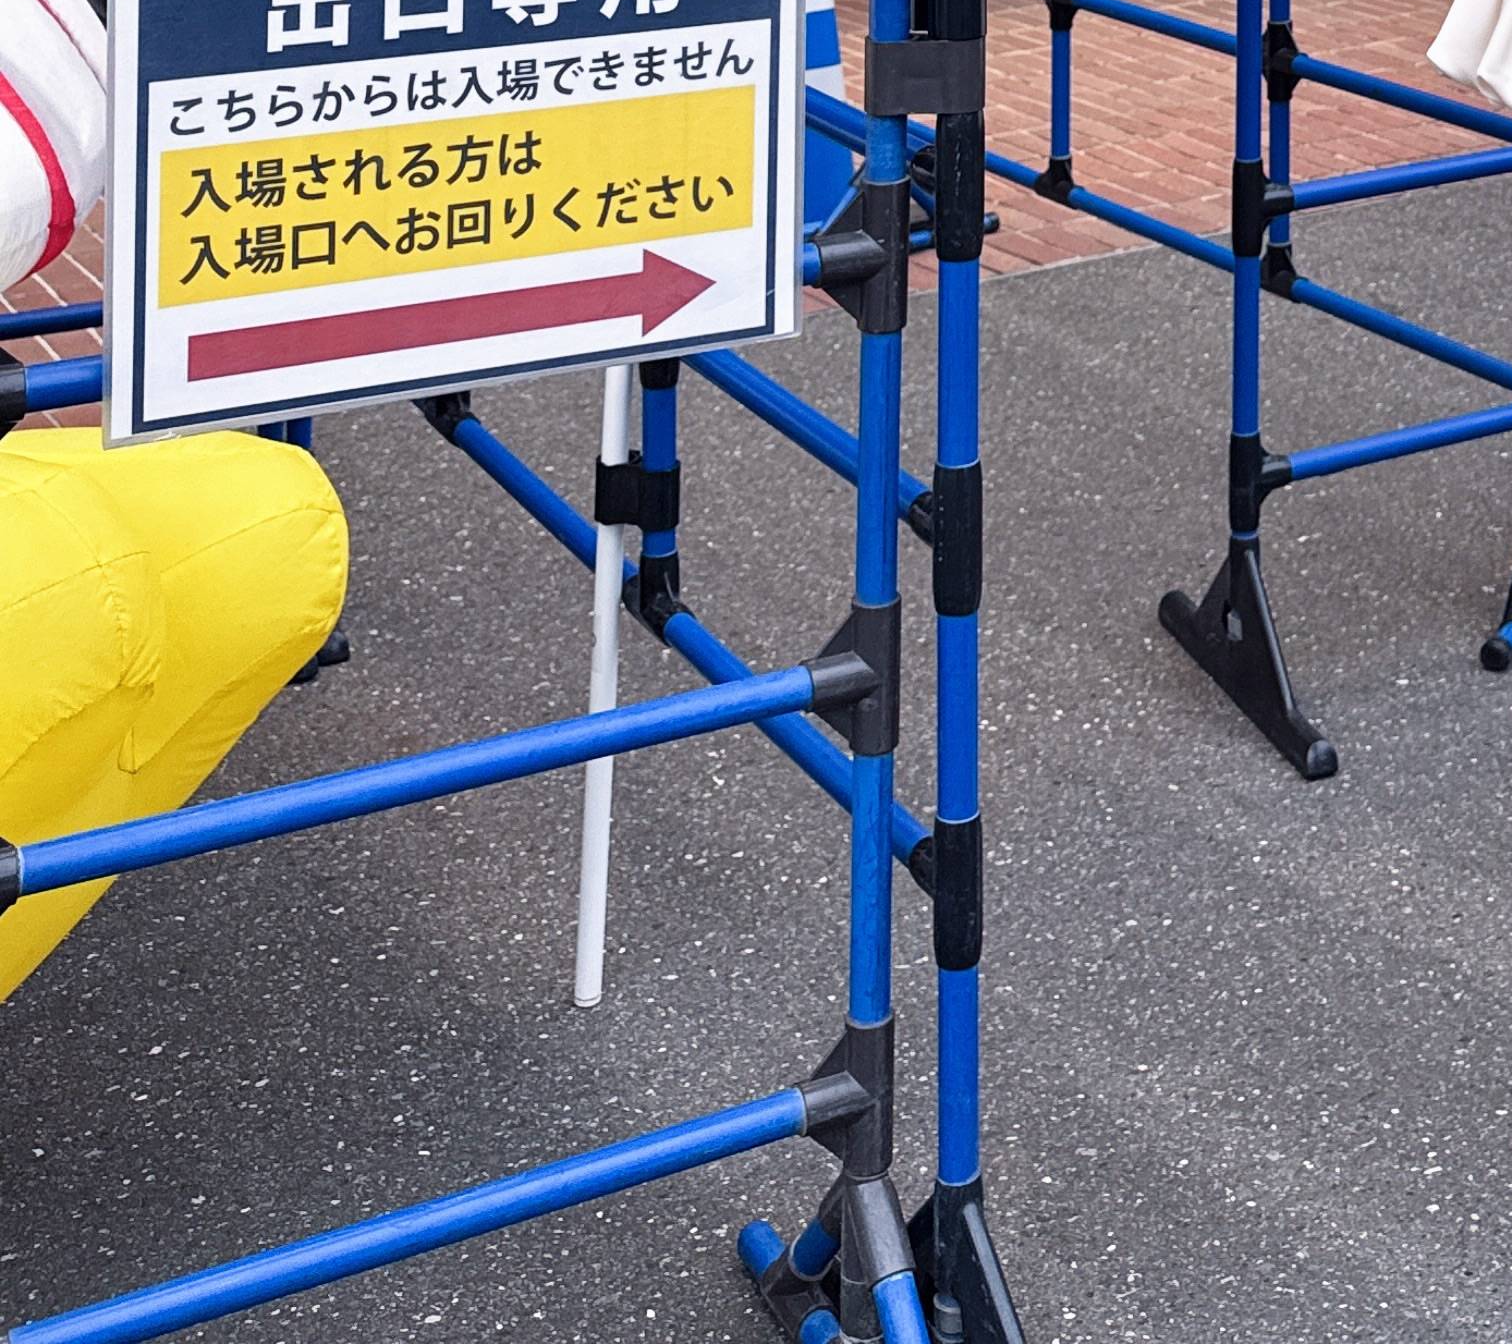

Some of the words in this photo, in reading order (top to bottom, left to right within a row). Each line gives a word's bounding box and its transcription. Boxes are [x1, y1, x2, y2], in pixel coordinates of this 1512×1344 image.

[169, 38, 755, 137] こちらからは入場できません
[180, 131, 543, 217] 入場される方は
[178, 173, 736, 285] 入場口へお回りください
